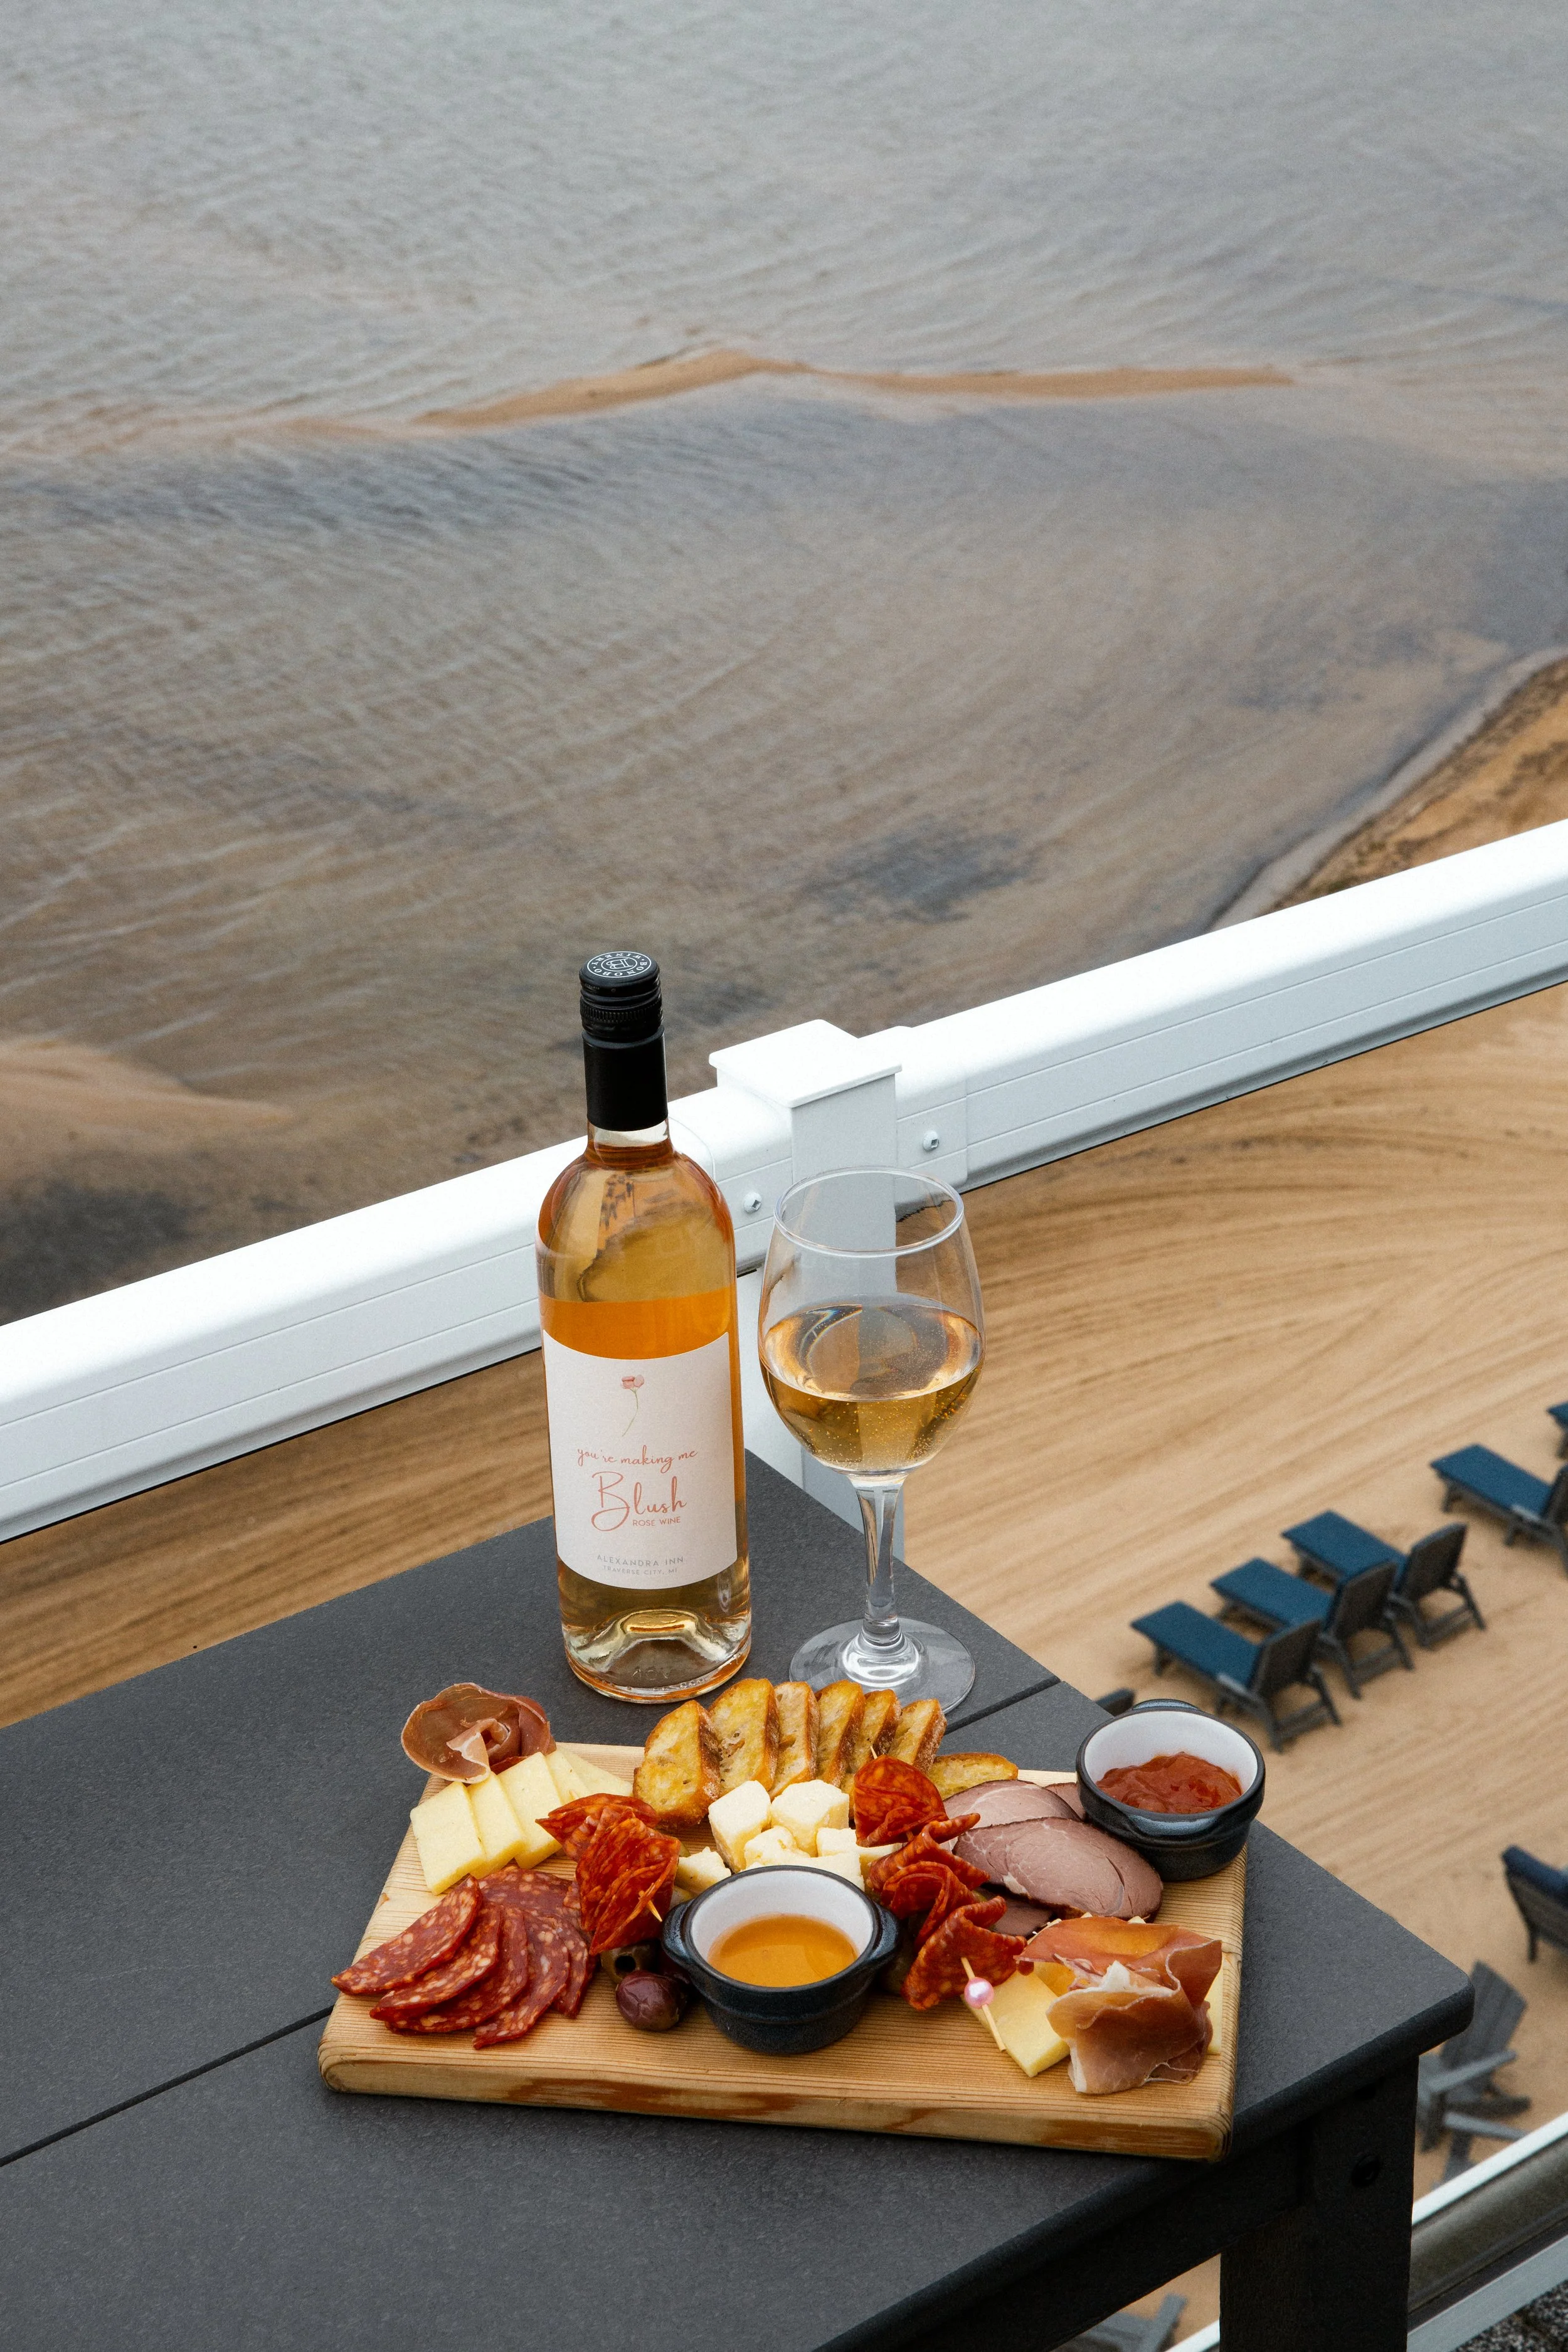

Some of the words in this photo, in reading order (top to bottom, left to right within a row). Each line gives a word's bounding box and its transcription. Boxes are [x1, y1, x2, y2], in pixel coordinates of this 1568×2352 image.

[591, 953, 641, 965] WINERY
[594, 961, 648, 976] BONOBO
[578, 1448, 617, 1467] you're
[620, 1444, 675, 1474] making
[678, 1450, 698, 1460] me
[591, 1471, 687, 1532] Blush
[659, 1516, 681, 1525] WINE
[597, 1554, 659, 1567] ALEXANDRA
[665, 1556, 684, 1565] INN
[603, 1565, 640, 1575] TRAVERSE
